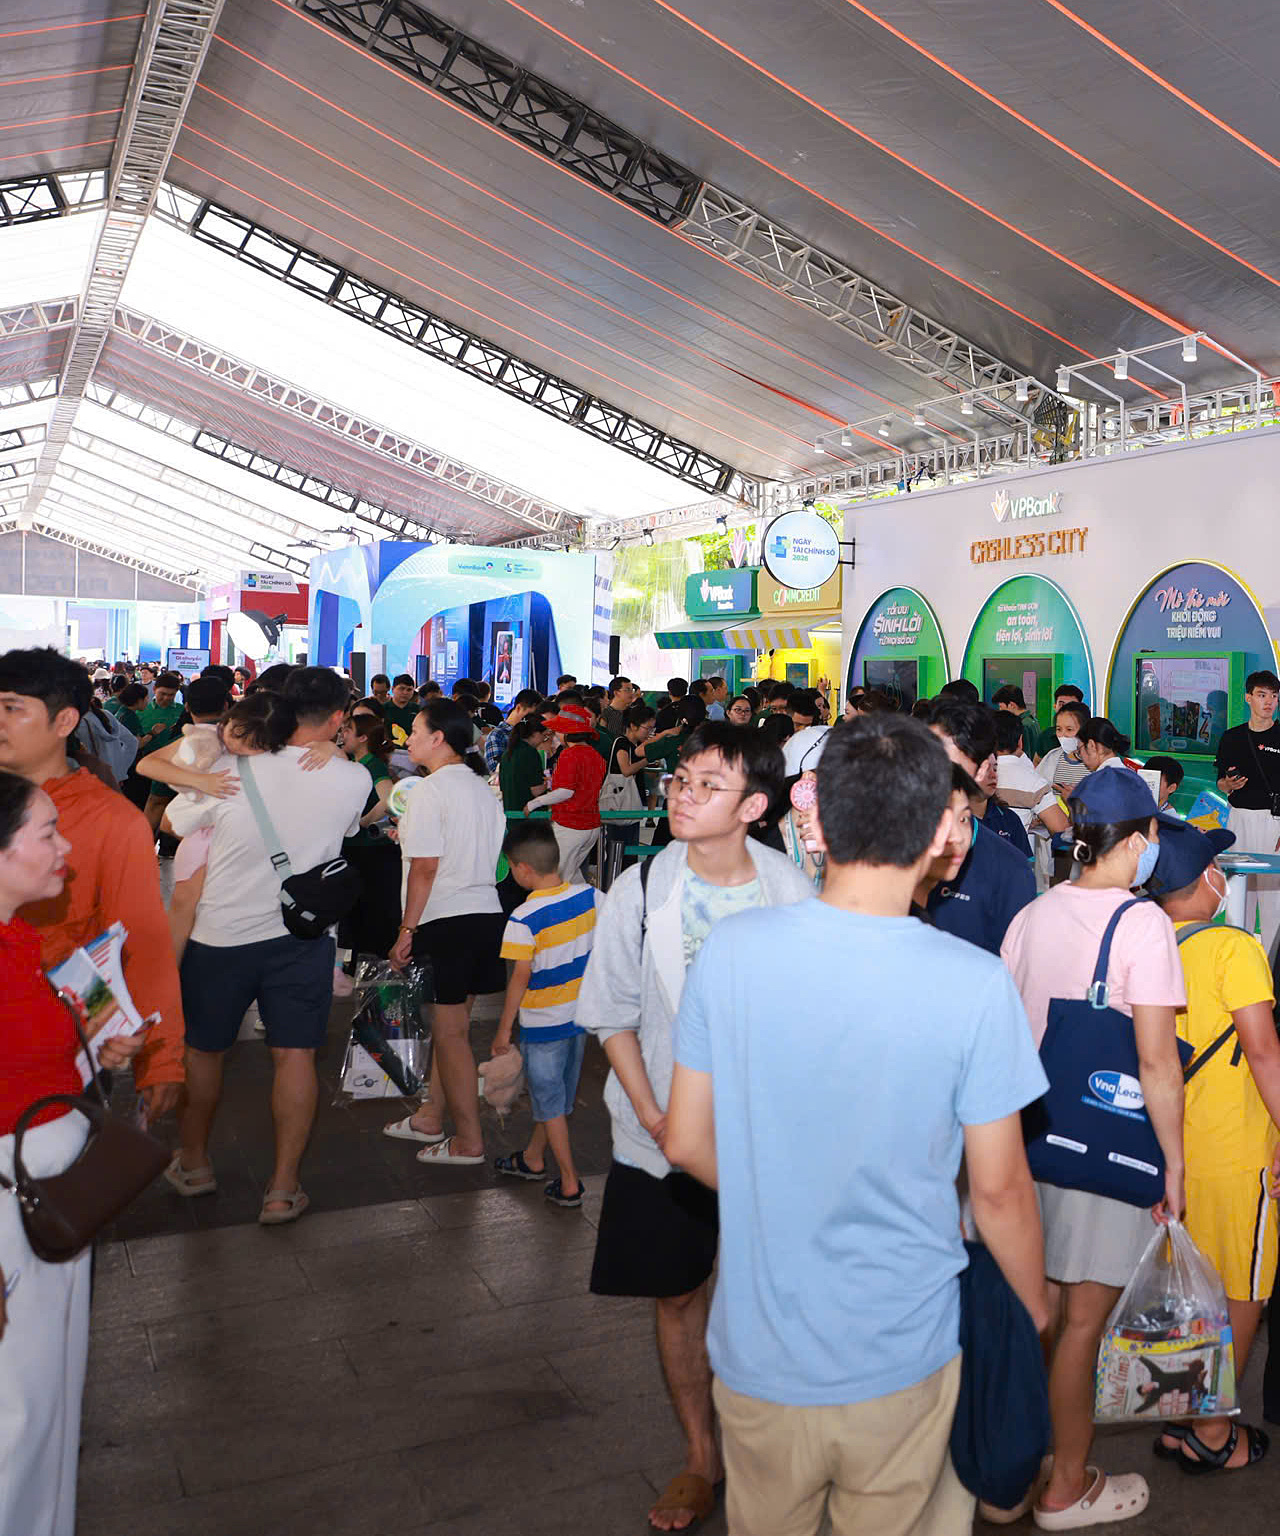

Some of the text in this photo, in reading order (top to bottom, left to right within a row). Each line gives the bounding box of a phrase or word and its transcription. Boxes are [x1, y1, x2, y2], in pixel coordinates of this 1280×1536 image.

[1010, 492, 1059, 519] VPBank
[792, 536, 812, 546] NGÀY
[970, 527, 1089, 564] CASHLESS CITY
[804, 545, 825, 556] CHÍNH
[1007, 616, 1017, 626] an
[1206, 626, 1222, 638] VUI
[1094, 1077, 1116, 1095] Vina
